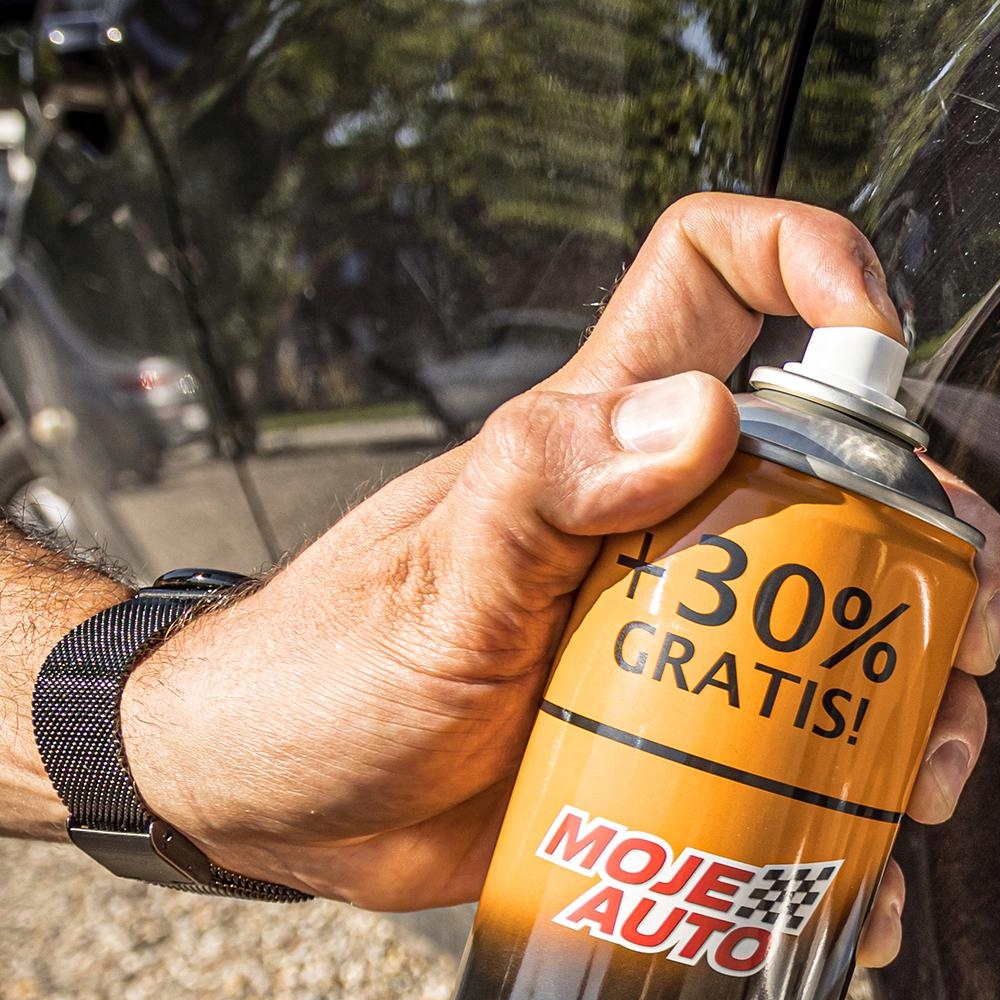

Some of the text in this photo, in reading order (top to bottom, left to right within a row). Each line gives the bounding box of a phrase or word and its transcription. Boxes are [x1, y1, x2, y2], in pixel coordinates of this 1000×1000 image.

[616, 532, 909, 683] +30%
[613, 620, 870, 745] GRATIS!
[543, 811, 757, 914] MOJE
[565, 885, 772, 973] AUTO
